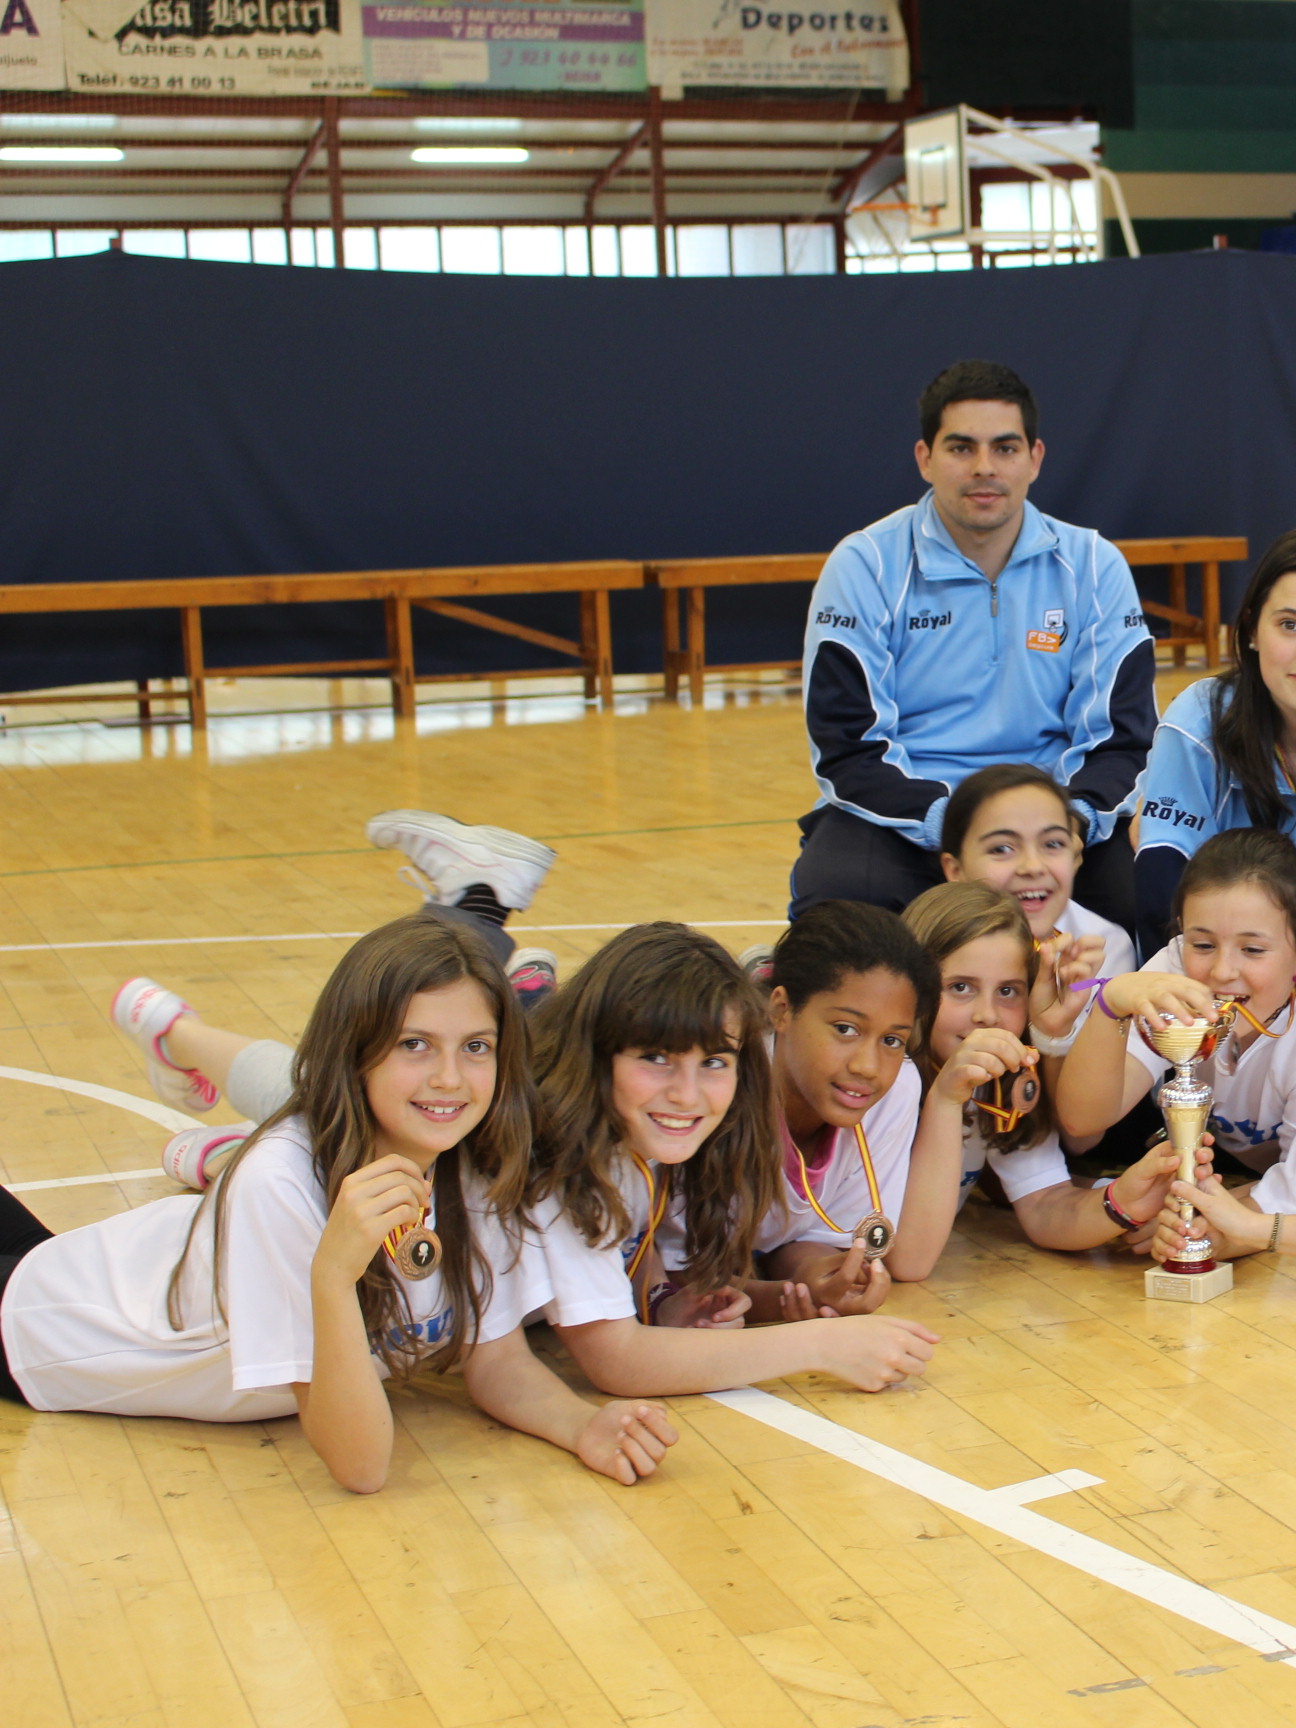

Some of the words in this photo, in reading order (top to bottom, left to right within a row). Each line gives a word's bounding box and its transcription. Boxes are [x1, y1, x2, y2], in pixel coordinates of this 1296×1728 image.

[740, 7, 890, 36] Deportes
[118, 43, 196, 57] CARNES
[203, 45, 217, 57] A
[224, 46, 249, 59] LA
[257, 47, 323, 60] BRASA
[129, 75, 160, 89] 923
[167, 76, 184, 89] 41
[191, 76, 212, 89] 00
[218, 77, 236, 89] 13
[815, 611, 857, 630] Royal
[909, 611, 952, 630] Royal
[1142, 800, 1206, 831] Royal
